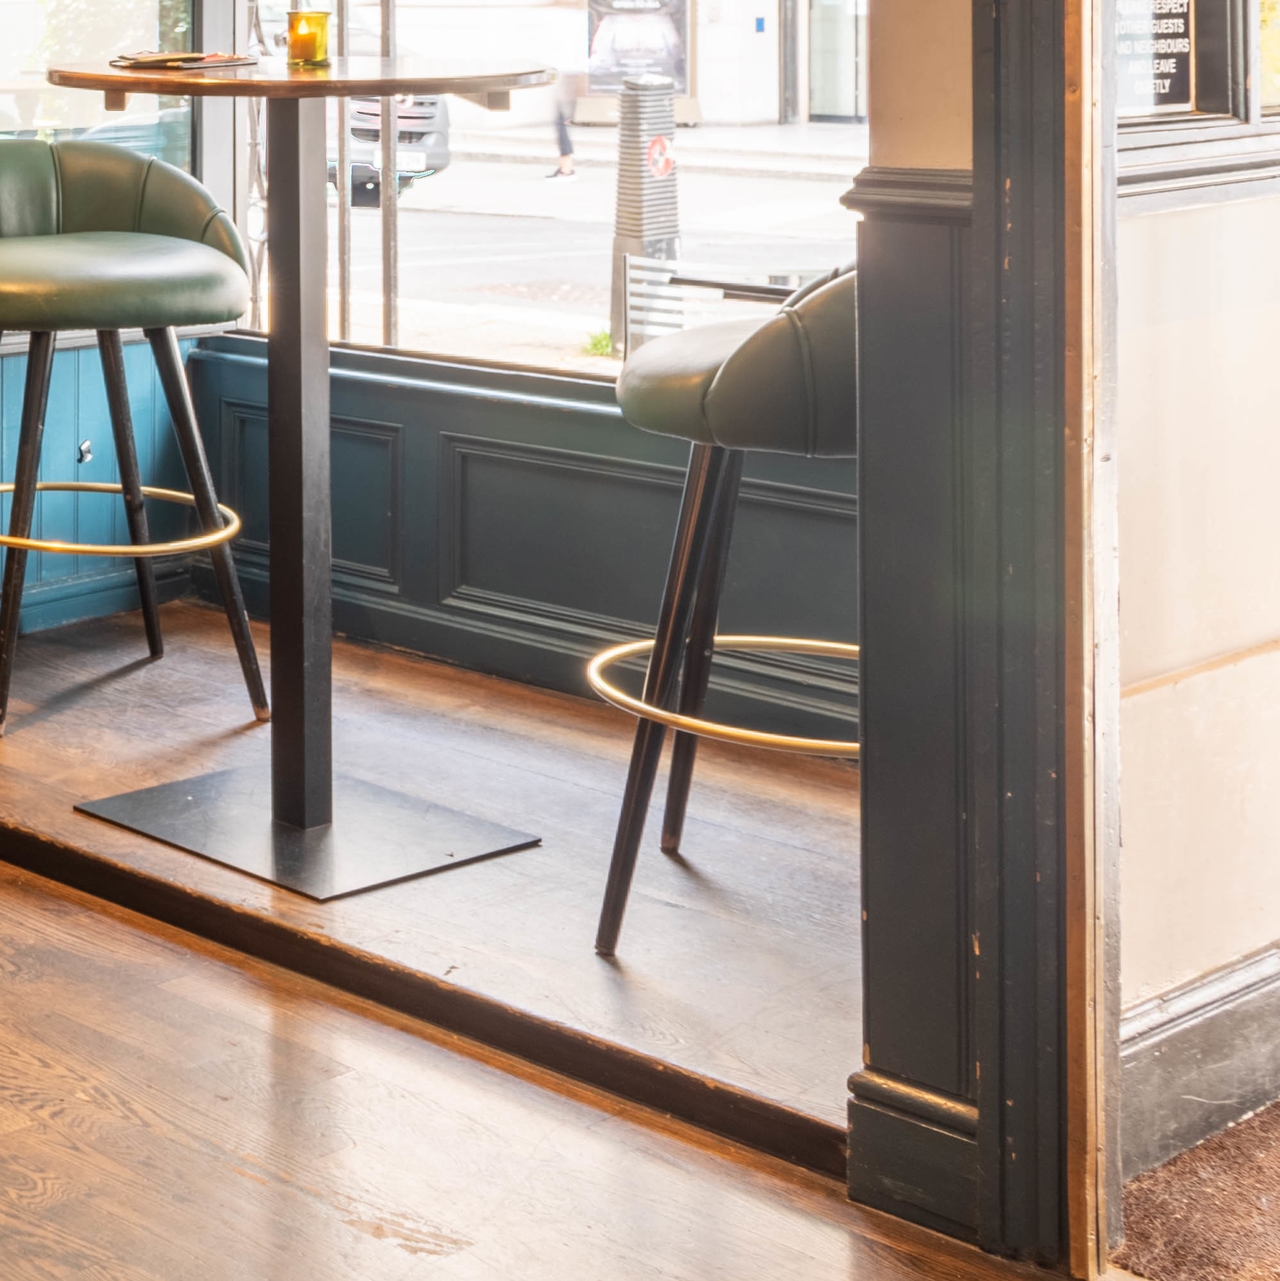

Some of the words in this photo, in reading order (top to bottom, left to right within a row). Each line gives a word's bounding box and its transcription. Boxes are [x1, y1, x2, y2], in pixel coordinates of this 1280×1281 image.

[1119, 19, 1149, 35] OTHER
[1151, 18, 1185, 33] GUESTS
[1134, 38, 1190, 54] NEIGHBOURS
[1148, 58, 1177, 73] LEAVE
[1134, 79, 1171, 95] QUIETLY
